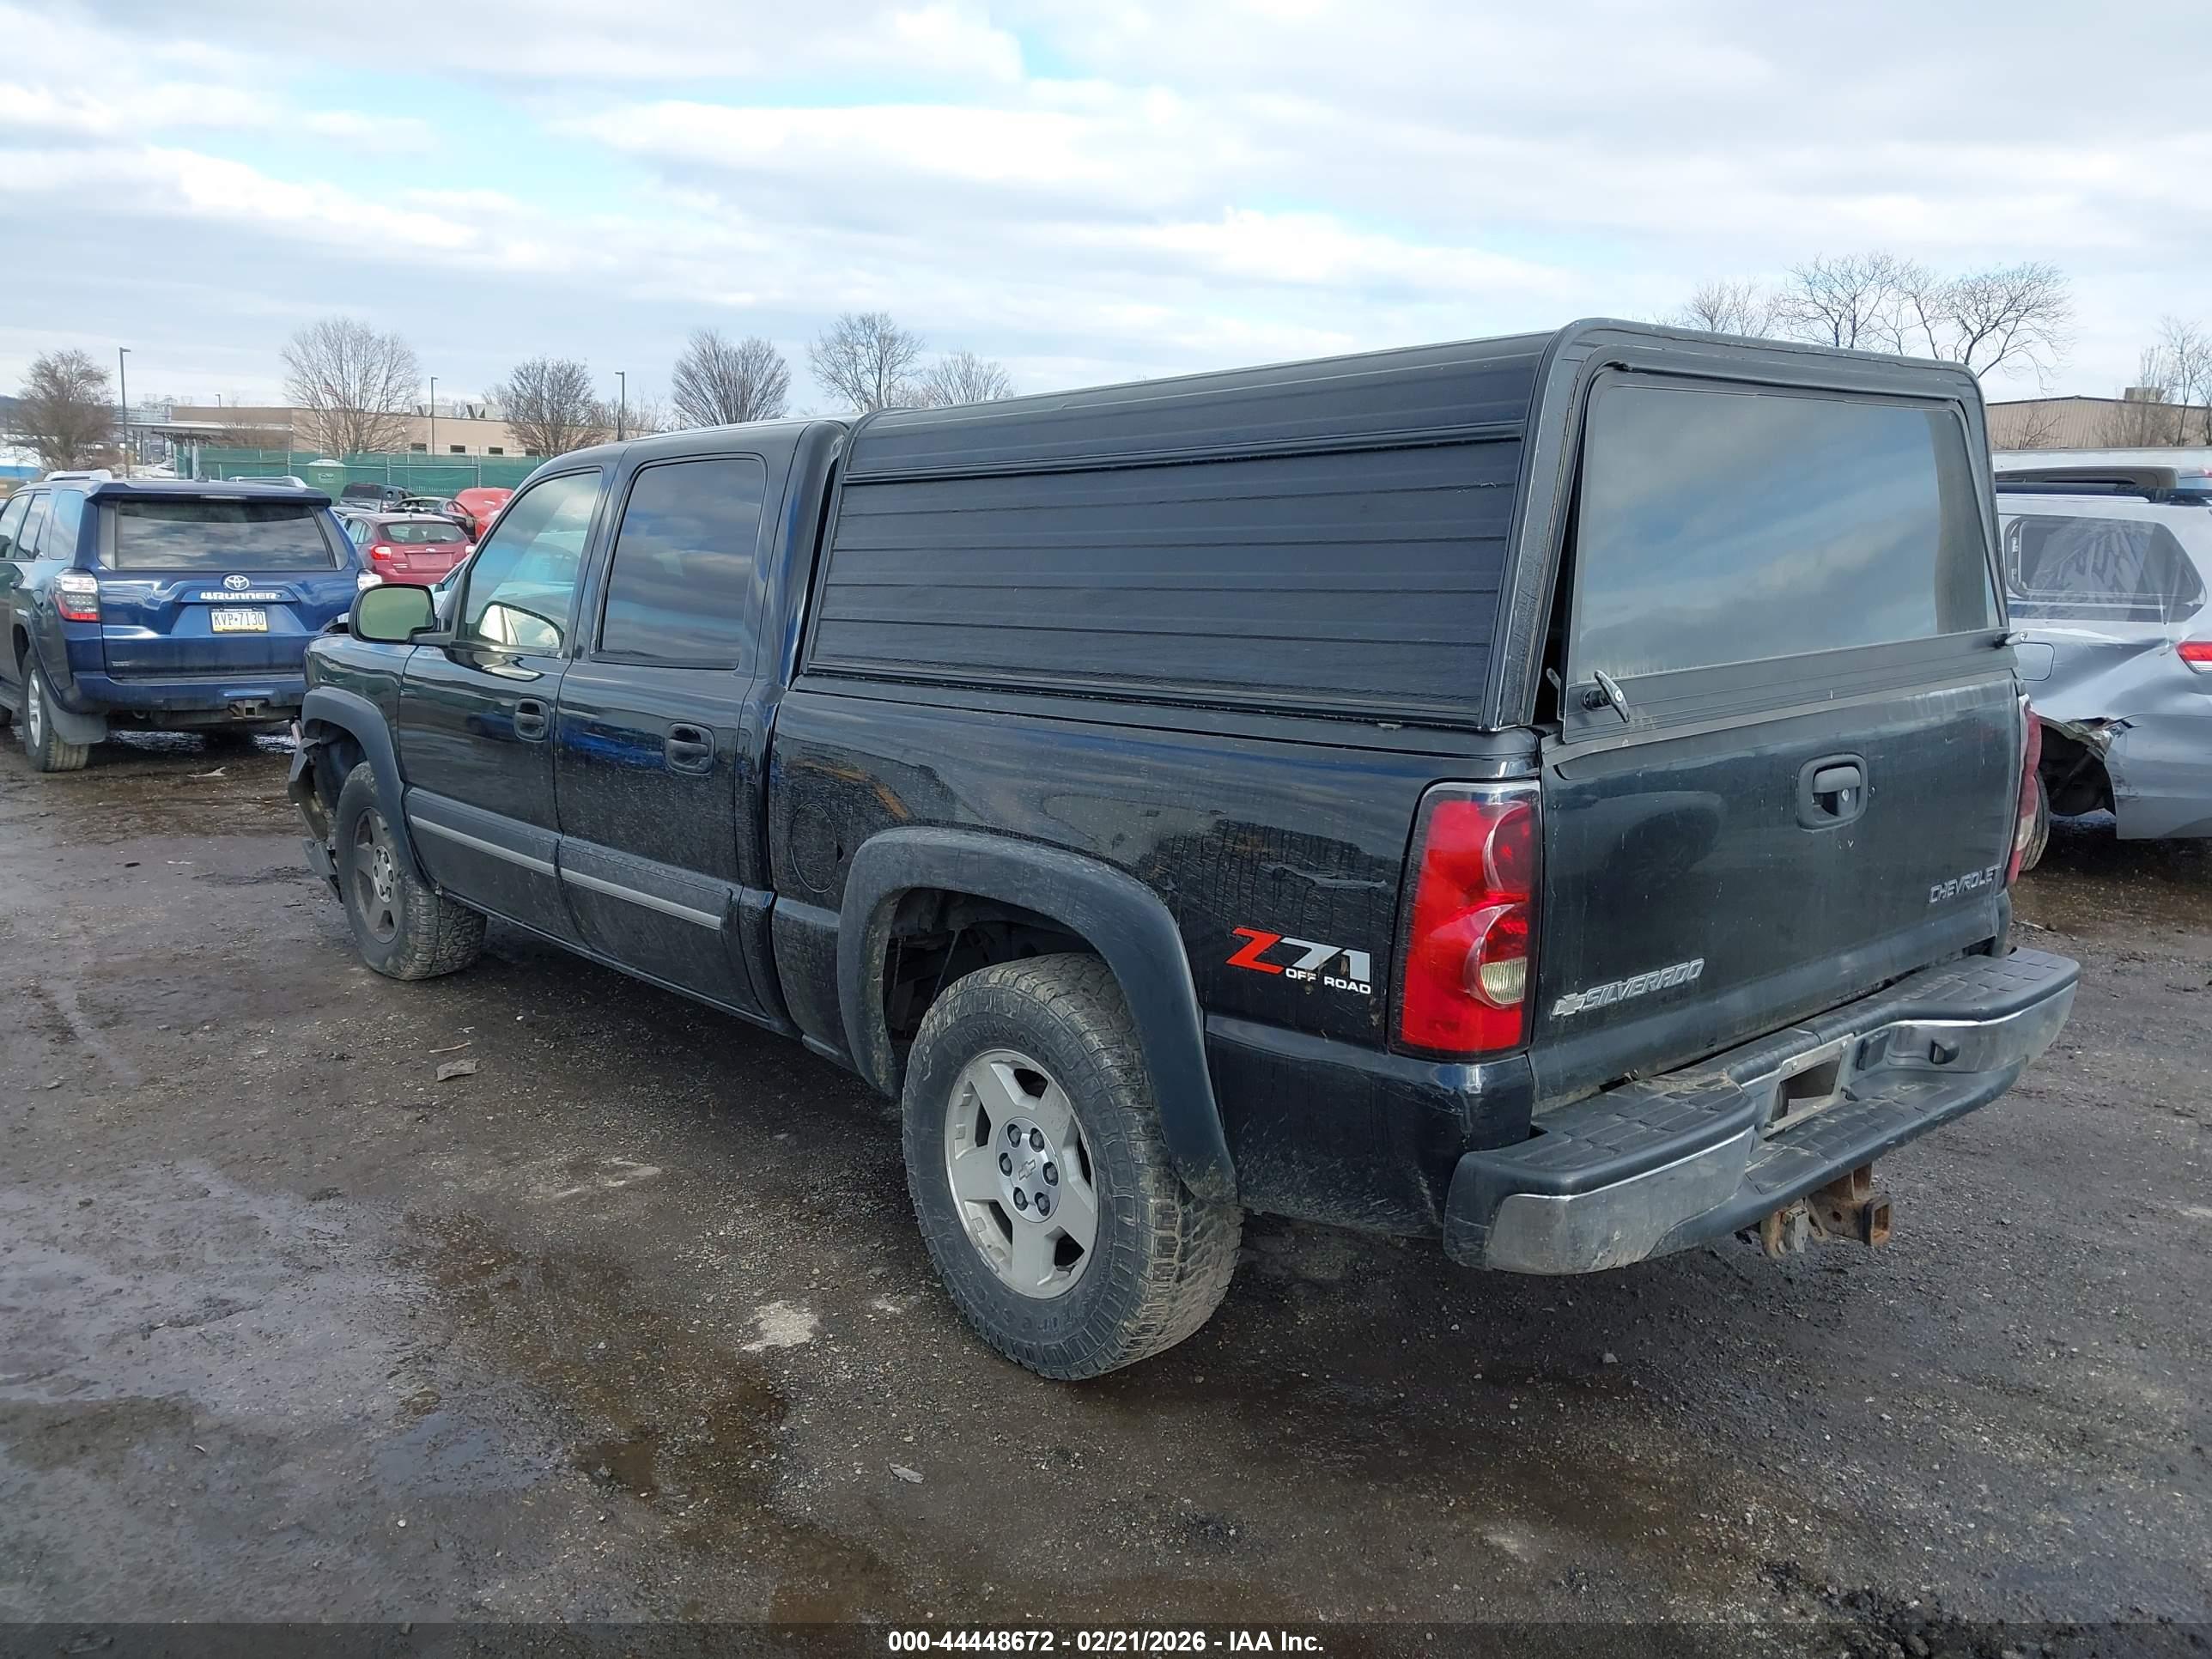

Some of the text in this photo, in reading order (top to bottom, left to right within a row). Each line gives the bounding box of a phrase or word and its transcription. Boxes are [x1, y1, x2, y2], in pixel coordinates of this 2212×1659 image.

[1929, 864, 2002, 903] CHEVROLET
[1225, 927, 1371, 983] Z71
[1285, 968, 1371, 994] OFF ROAD
[1583, 958, 1705, 1011] SILVERADO
